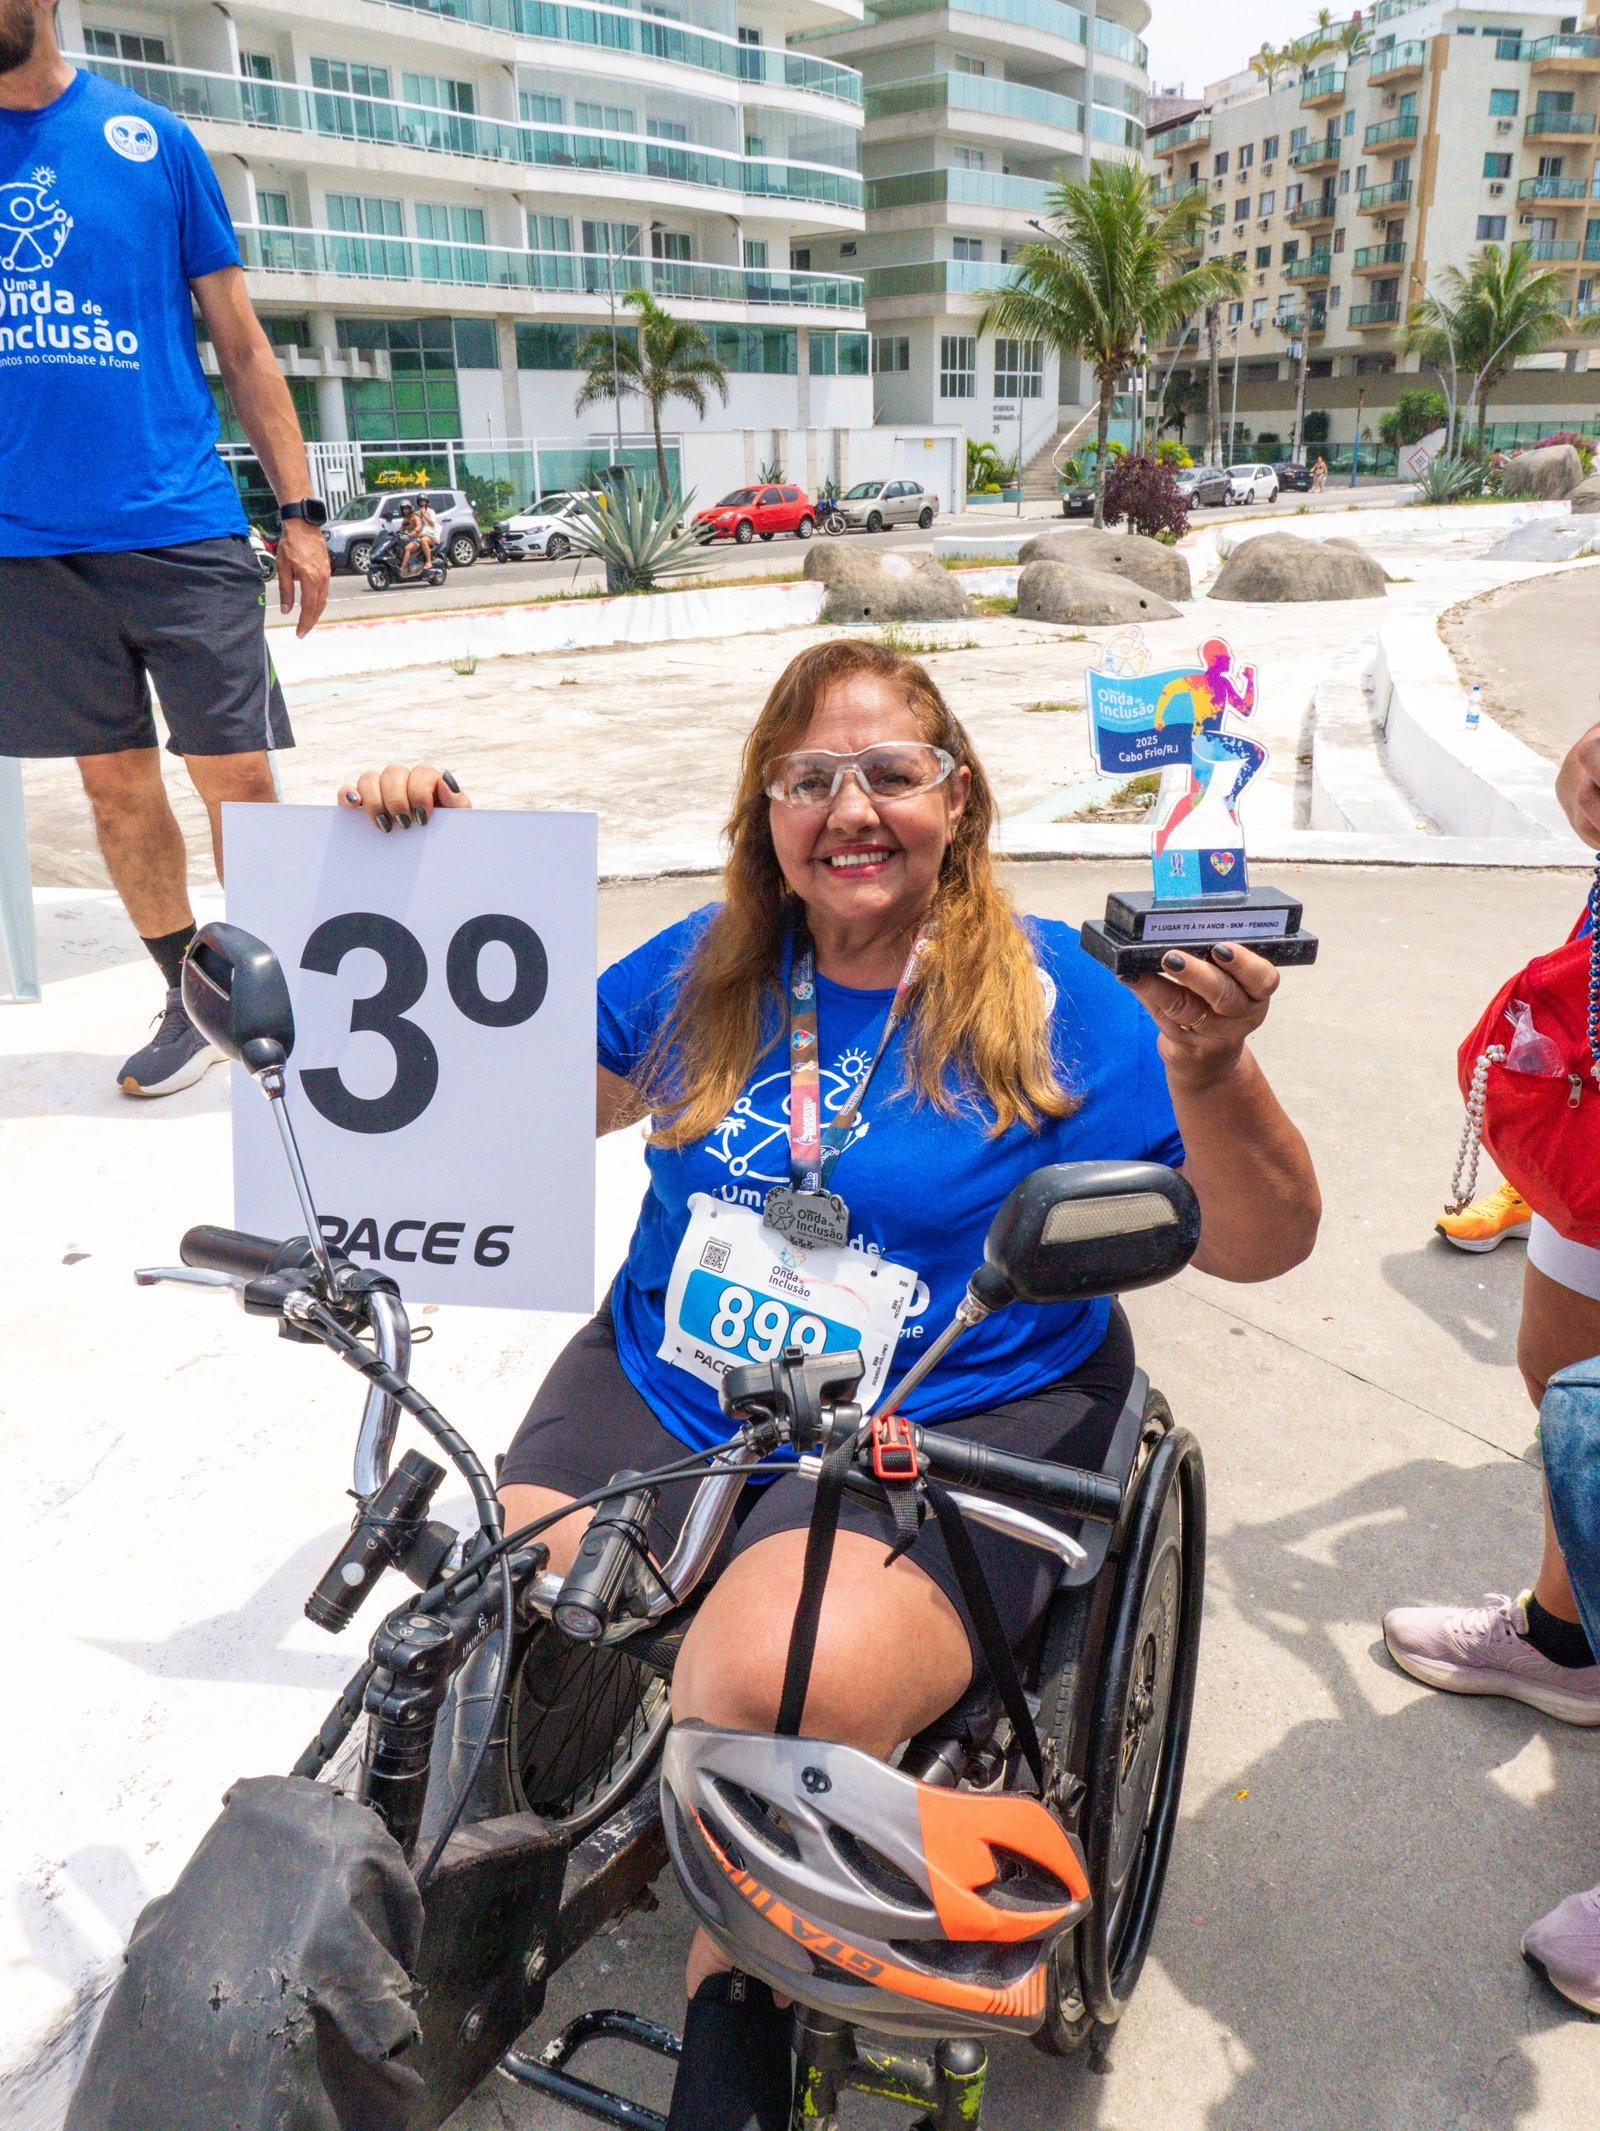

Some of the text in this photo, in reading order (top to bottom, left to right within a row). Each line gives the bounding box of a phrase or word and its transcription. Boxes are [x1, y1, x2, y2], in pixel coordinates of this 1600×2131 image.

[3, 278, 37, 292] Uma
[0, 280, 103, 317] nda de
[0, 315, 139, 355] nclusão
[0, 352, 140, 370] ntos no combate à fome
[1097, 689, 1134, 706] Onda
[1099, 702, 1155, 719] Inclusão
[1136, 735, 1158, 748] 2025
[1118, 744, 1179, 762] Cabo Frio/RJ
[299, 912, 549, 1134] 3º
[721, 1184, 766, 1207] Um
[798, 1209, 827, 1226] Onda
[797, 1221, 843, 1241] Inclusão
[473, 1225, 515, 1267] 6
[772, 1266, 799, 1282] Onda
[768, 1274, 811, 1298] Inclusão
[710, 1285, 828, 1363] 899
[694, 1349, 736, 1376] PACE
